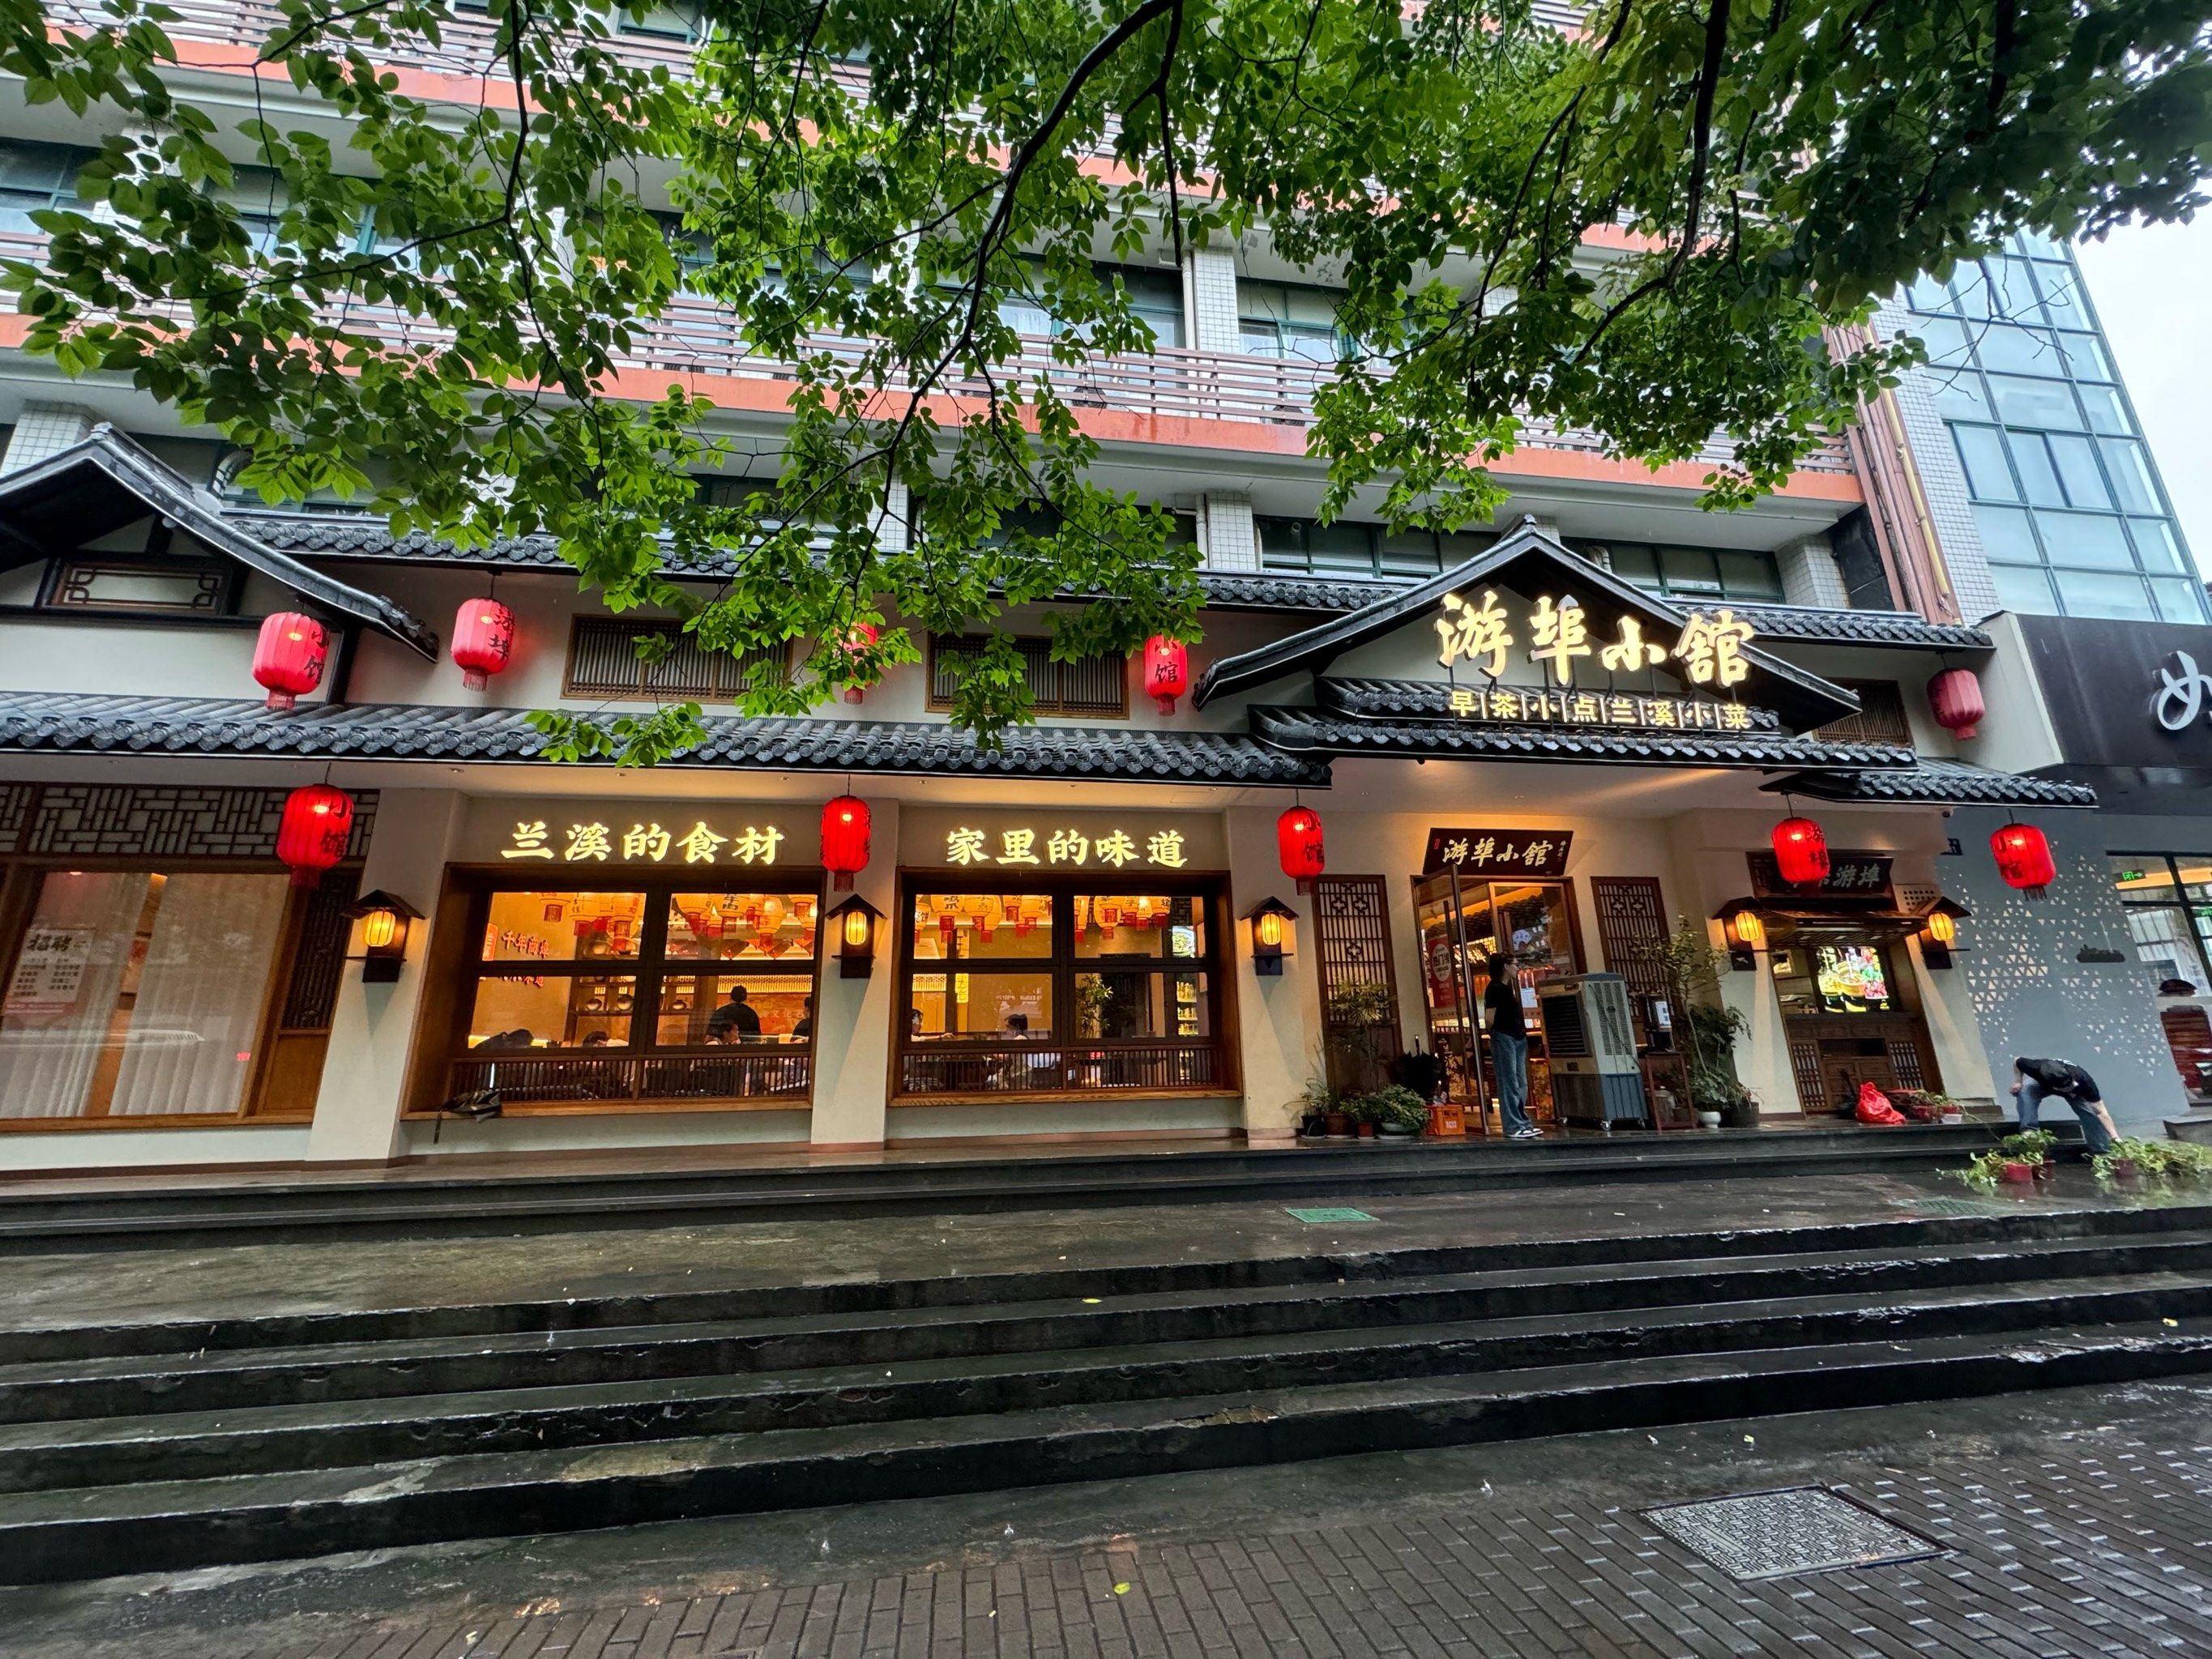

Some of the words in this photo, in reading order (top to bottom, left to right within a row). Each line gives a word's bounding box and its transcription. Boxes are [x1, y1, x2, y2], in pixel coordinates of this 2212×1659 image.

[501, 821, 784, 864] 兰溪的食材
[946, 827, 1188, 868] 家里的味道
